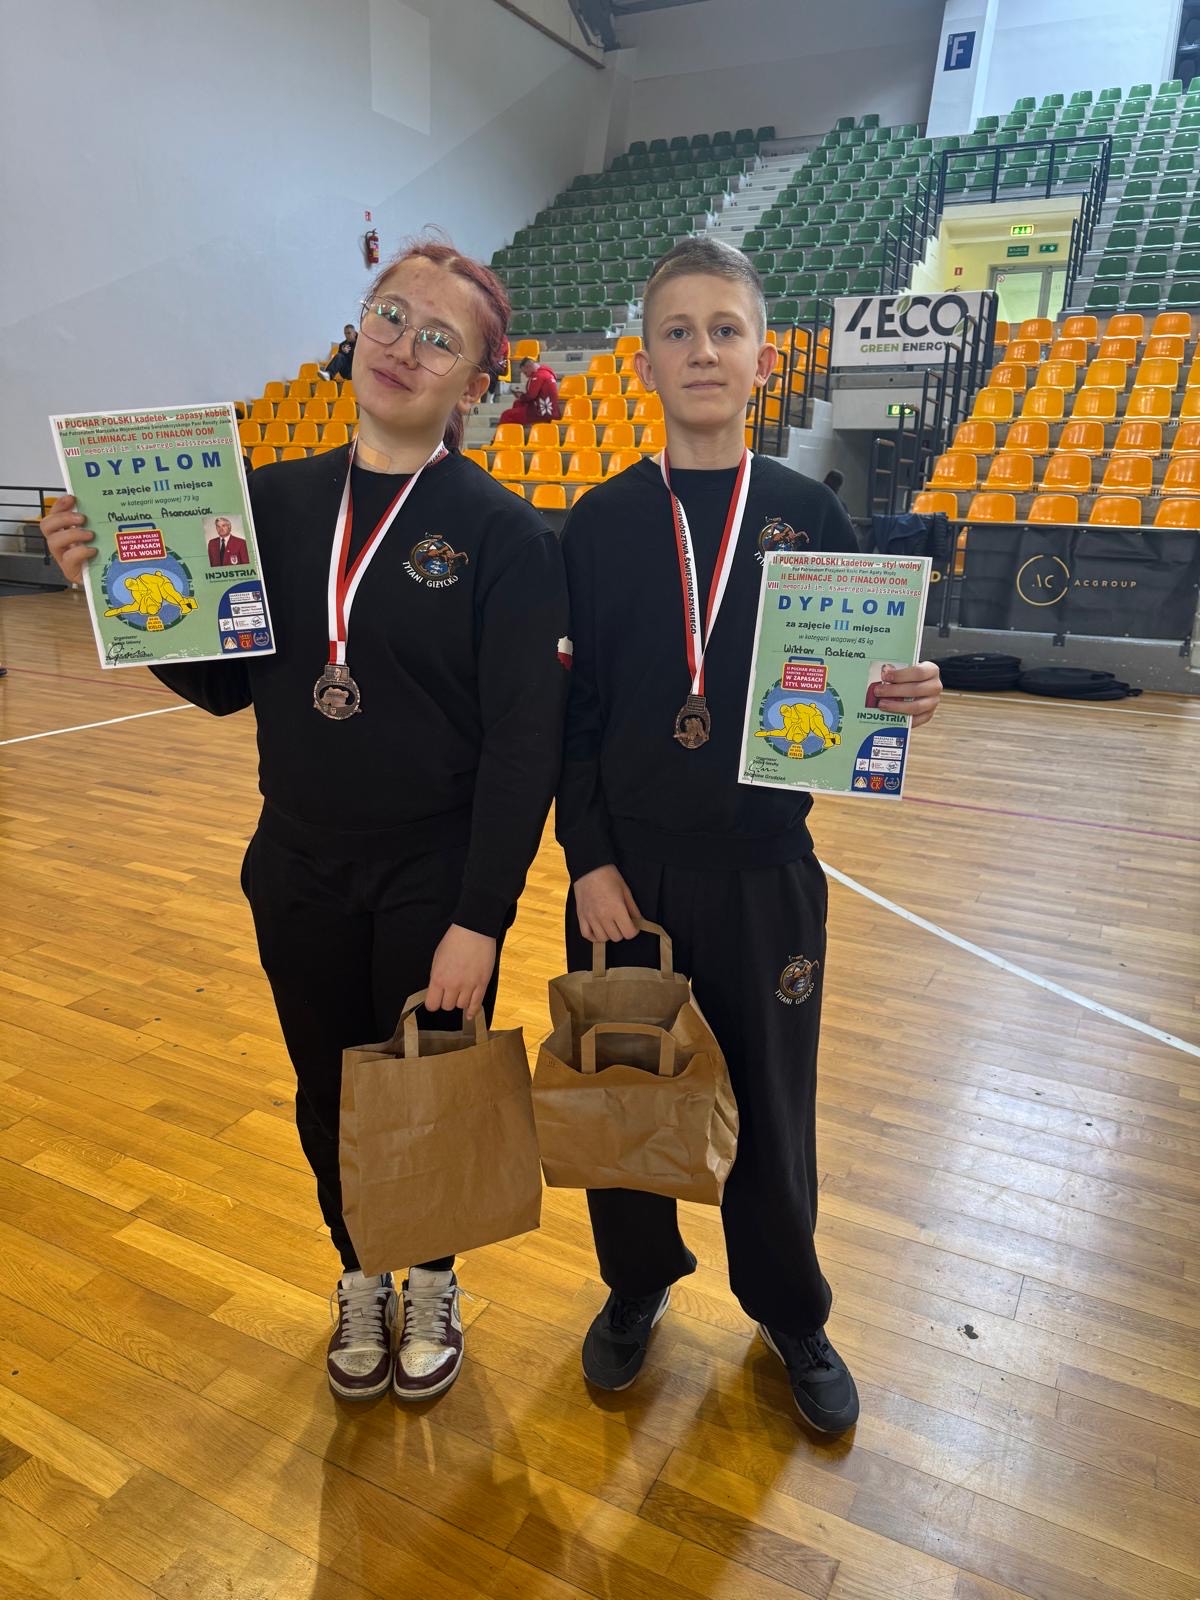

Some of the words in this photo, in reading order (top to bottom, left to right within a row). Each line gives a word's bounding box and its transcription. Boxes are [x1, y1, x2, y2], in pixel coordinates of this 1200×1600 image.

[950, 36, 967, 67] F
[860, 343, 899, 353] GREEN
[57, 421, 63, 430] II
[65, 418, 100, 429] PUCHAR
[102, 416, 132, 426] POLSKI
[134, 413, 168, 423] kadetek
[176, 411, 203, 421] zapasy
[205, 408, 231, 418] kobiet
[80, 437, 85, 445] II
[87, 433, 137, 445] ELIMINACJE
[141, 431, 153, 440] DO
[65, 447, 80, 457] VIII
[85, 451, 222, 477] DYPLOM
[116, 485, 151, 495] zajęcie
[153, 479, 170, 491] III
[174, 480, 213, 490] miejsca
[127, 498, 153, 506] kategorii
[155, 496, 182, 504] wagowej
[107, 511, 153, 522] Malwina
[773, 556, 777, 564] II
[780, 556, 809, 565] PUCHAR
[811, 557, 839, 566] POLSKI
[882, 560, 897, 569] styl
[899, 562, 922, 571] wolny
[205, 569, 257, 579] INDUSTRIA
[402, 560, 424, 583] TYTANI
[788, 573, 832, 582] ELIMINACJE
[837, 575, 848, 583] DO
[1074, 579, 1137, 588] ACGROUP
[768, 581, 779, 589] VIII
[683, 557, 697, 635] ŚWIĘTOKRZYSKIEGO
[778, 595, 905, 616] DYPLOM
[798, 621, 831, 630] zajęcie
[834, 620, 849, 631] III
[852, 624, 891, 634] miejsca
[805, 634, 830, 642] kategorii
[831, 636, 857, 644] wagowej
[793, 675, 823, 683] ZAPASACH
[857, 712, 907, 723] INDUSTRIA
[775, 989, 793, 1004] TYTANI
